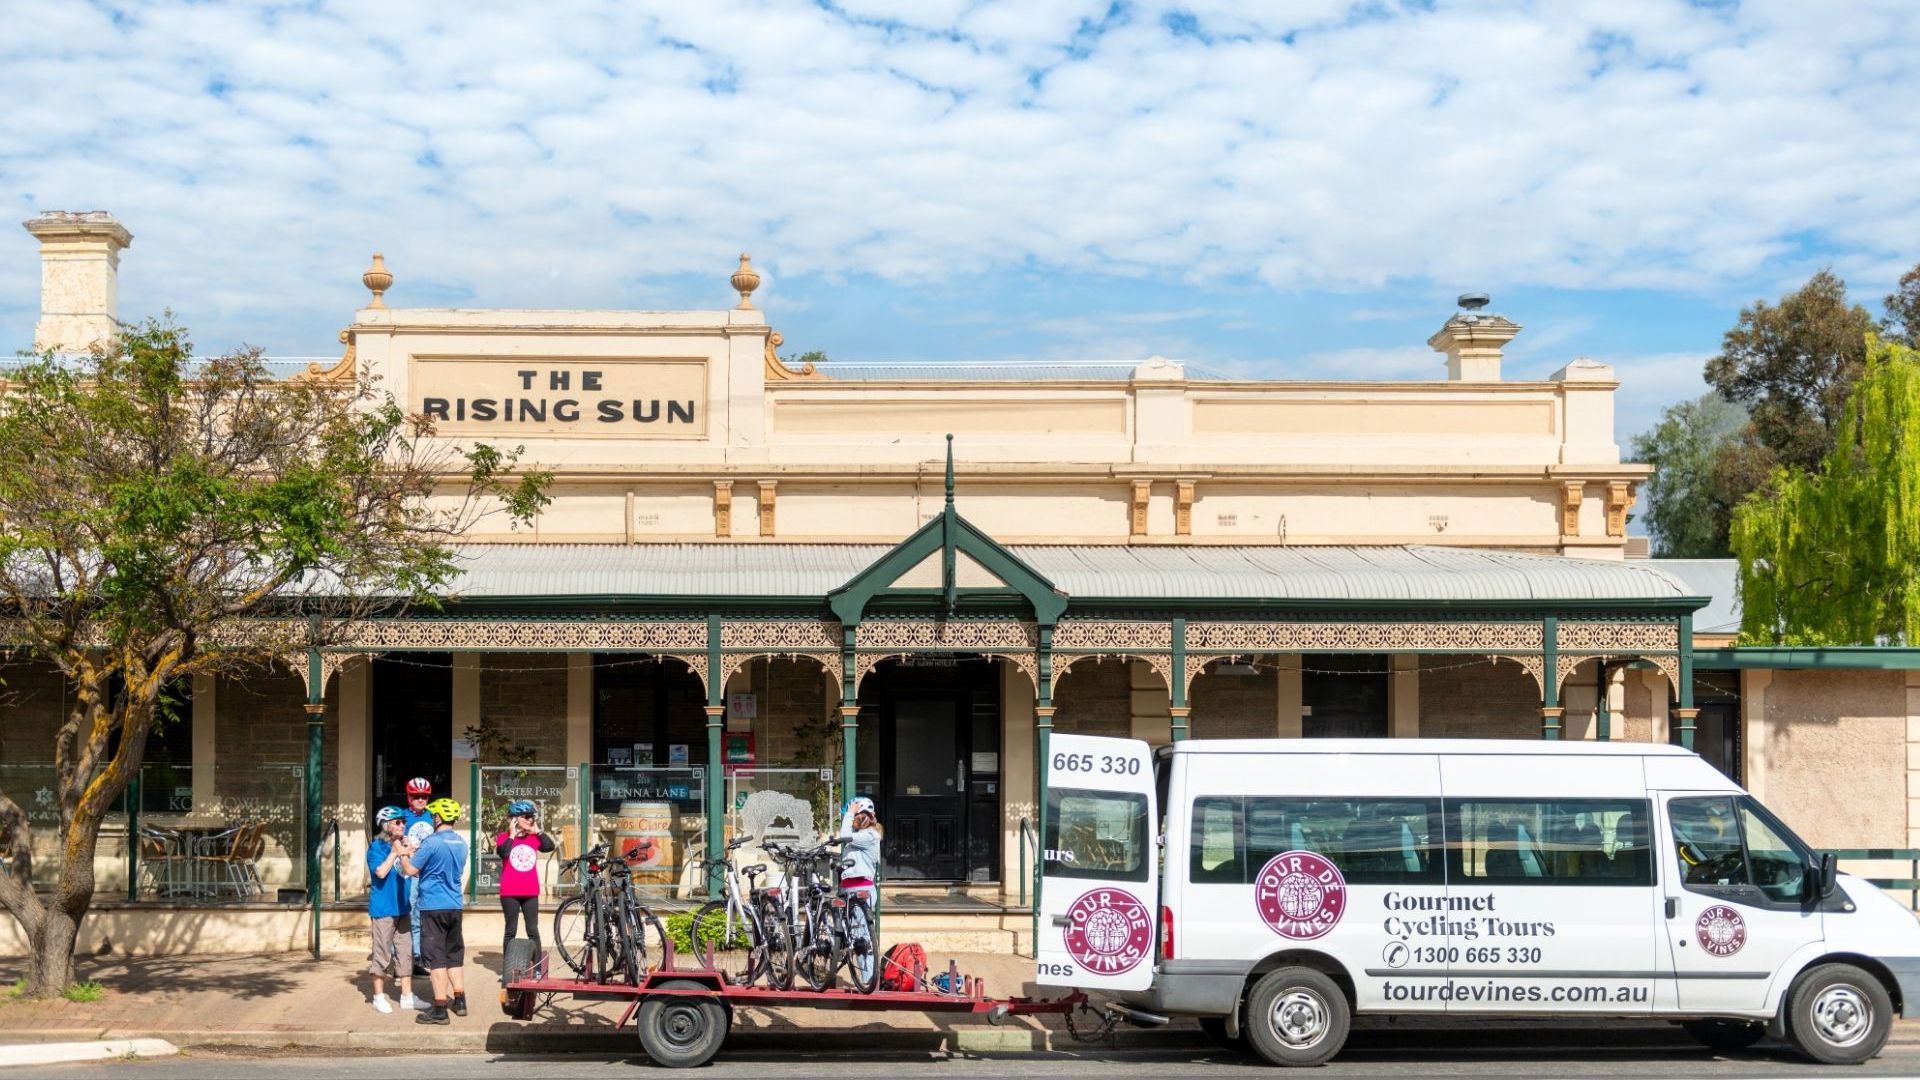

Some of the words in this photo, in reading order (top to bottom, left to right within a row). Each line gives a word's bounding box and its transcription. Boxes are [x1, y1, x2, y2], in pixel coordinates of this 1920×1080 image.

[518, 371, 602, 390] THE
[424, 398, 580, 422] RISING
[597, 400, 694, 423] SUN
[1053, 753, 1093, 772] 665
[1101, 756, 1140, 775] 330
[535, 786, 562, 796] PARK
[610, 787, 650, 798] PENNA
[656, 787, 687, 798] LANE
[1043, 850, 1074, 861] urs
[1261, 857, 1302, 900] TOUR
[1318, 869, 1340, 893] DE
[1383, 891, 1496, 911] Gourmet
[1068, 893, 1111, 934] TOUR
[1126, 906, 1146, 930] DE
[1278, 908, 1334, 936] VINES
[1699, 908, 1723, 931] TOUR
[1732, 917, 1743, 930] DE
[1383, 916, 1479, 940] Cycling
[1482, 917, 1556, 937] Tours
[1413, 947, 1459, 963] 1300
[1465, 947, 1500, 963] 665
[1507, 947, 1542, 963] 330
[1707, 939, 1740, 953] VINES
[1083, 945, 1140, 971] VINES
[1037, 963, 1073, 976] nes
[1383, 980, 1648, 1002] tourdevines.com.au
